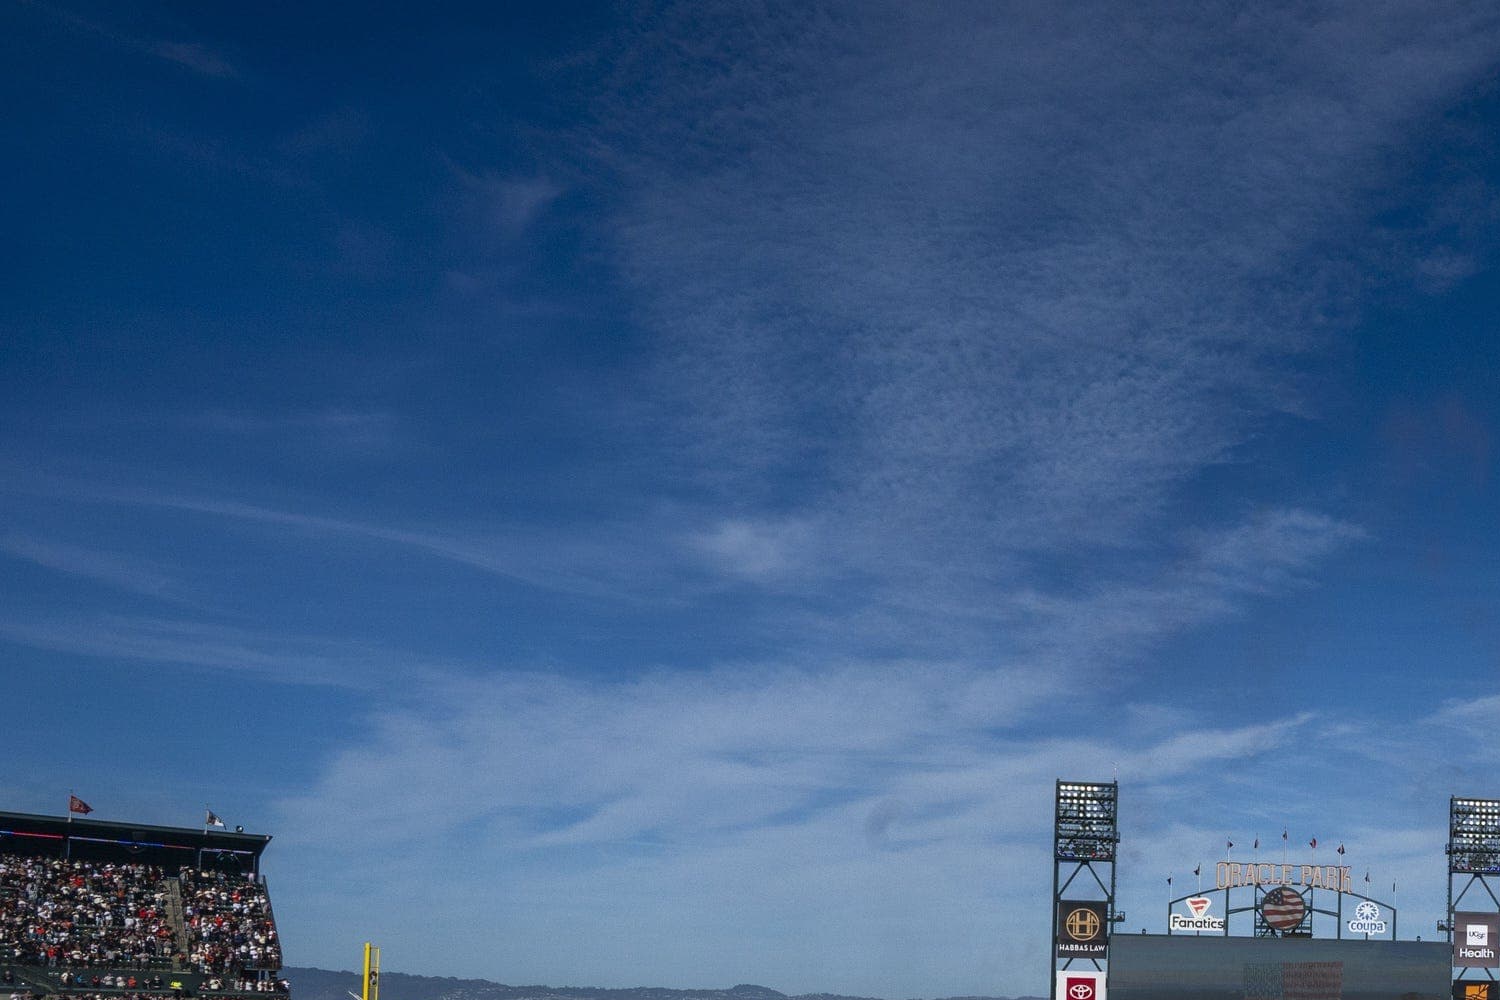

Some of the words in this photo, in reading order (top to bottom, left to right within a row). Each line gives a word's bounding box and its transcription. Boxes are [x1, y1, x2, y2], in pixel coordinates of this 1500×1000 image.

[1216, 862, 1293, 890] ORACLE
[1301, 866, 1352, 893] PARK
[1172, 916, 1225, 929] Fanatics
[1350, 921, 1385, 934] coupa
[1459, 948, 1495, 958] Health
